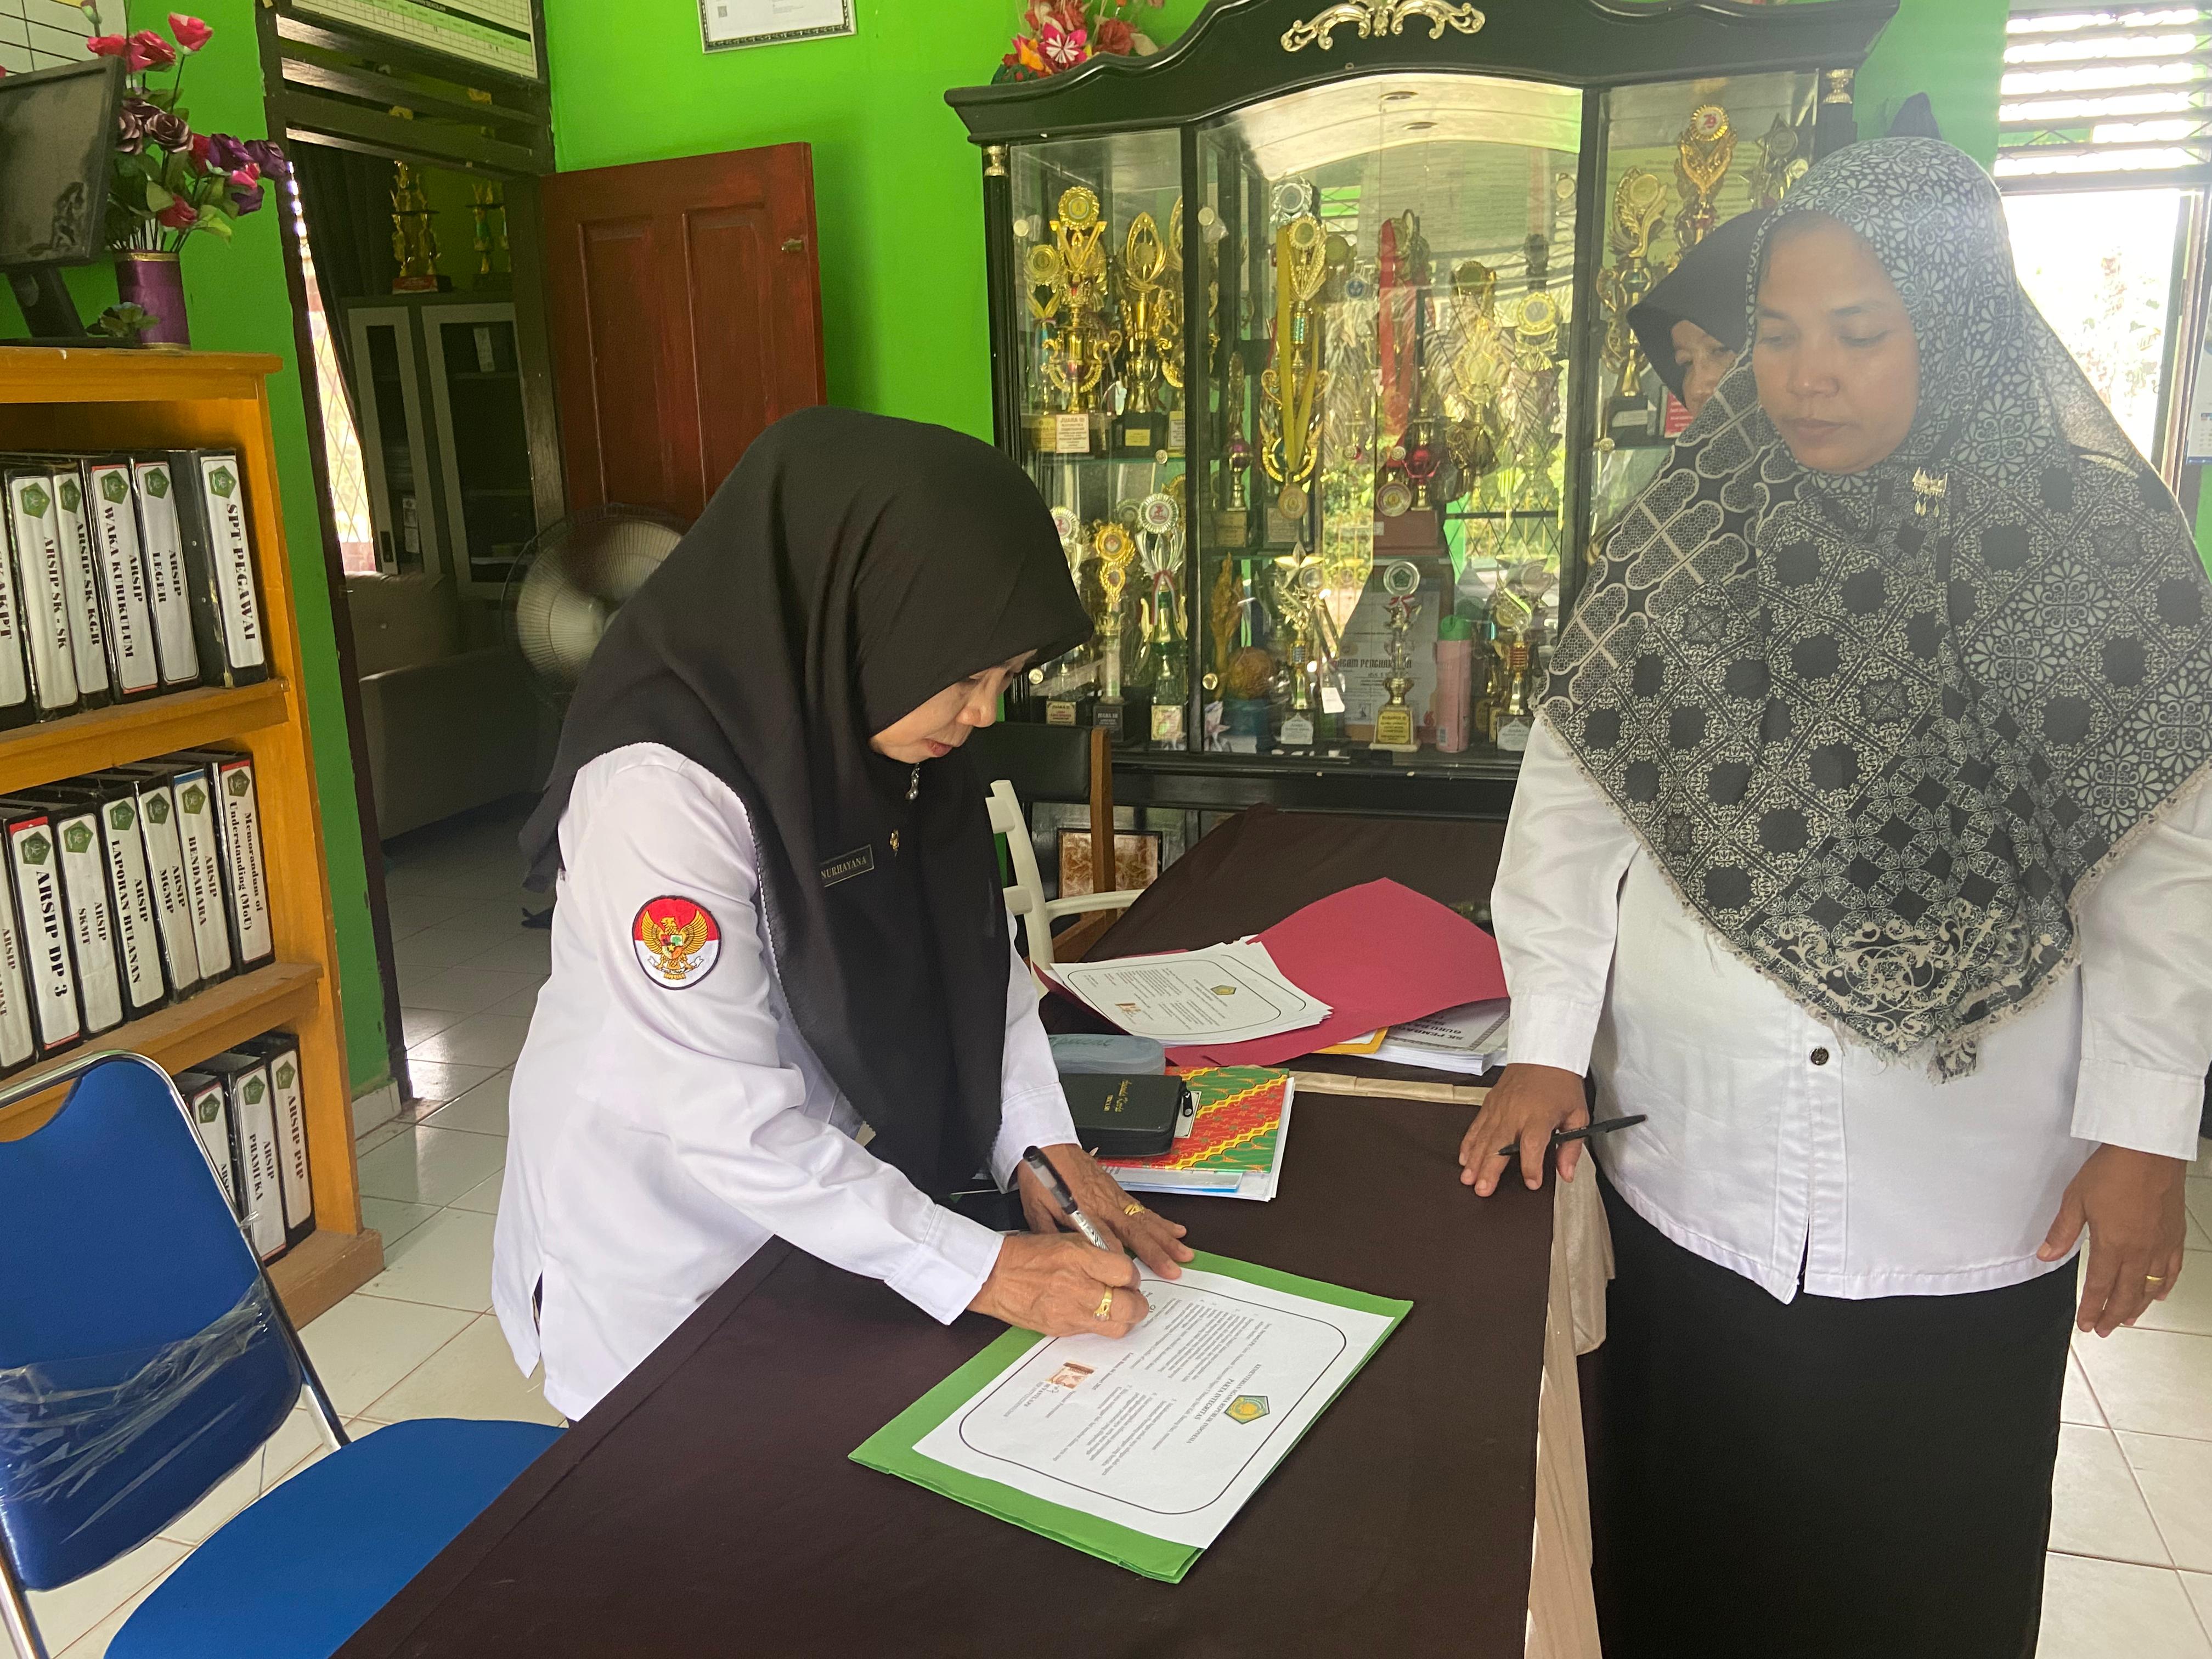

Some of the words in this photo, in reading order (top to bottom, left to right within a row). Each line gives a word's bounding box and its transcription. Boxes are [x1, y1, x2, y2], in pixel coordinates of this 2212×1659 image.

[226, 503, 241, 540] SPT
[44, 537, 59, 587] ARSIP
[77, 521, 89, 574] ARSIP
[84, 579, 94, 602] SK
[104, 506, 119, 556] WAKA
[112, 561, 134, 658] KURIKULUM
[129, 555, 143, 602] ARSIP
[153, 552, 166, 602] LEGER
[168, 550, 182, 596] ARSIP
[233, 548, 256, 641] PEGAWAI
[53, 592, 63, 613] SK
[57, 628, 66, 649] SK
[87, 608, 99, 645] KGB
[188, 836, 207, 926] BENDAHARA
[205, 855, 217, 897] ARSIP
[230, 801, 246, 891] Understanding
[240, 893, 252, 930] (MoU)
[245, 812, 259, 896] Memorandum
[256, 900, 263, 911] of
[820, 855, 867, 879] NURHAYANA
[36, 871, 59, 938] ARSIP
[134, 878, 148, 922] ARSIP
[160, 868, 174, 914] MGMP
[172, 865, 185, 907] ARSIP
[78, 908, 91, 945] SKMT
[94, 902, 106, 940] ARSIP
[111, 839, 131, 911] LAPORAN
[123, 915, 141, 984] BULANAN
[2, 928, 15, 969] ARSIP
[48, 945, 64, 977] DP
[54, 984, 67, 997] 3
[287, 1095, 300, 1145] ARSIP
[294, 1150, 304, 1180] PIP
[250, 1133, 263, 1201] PRAMUKA
[263, 1141, 274, 1180] ARSIP
